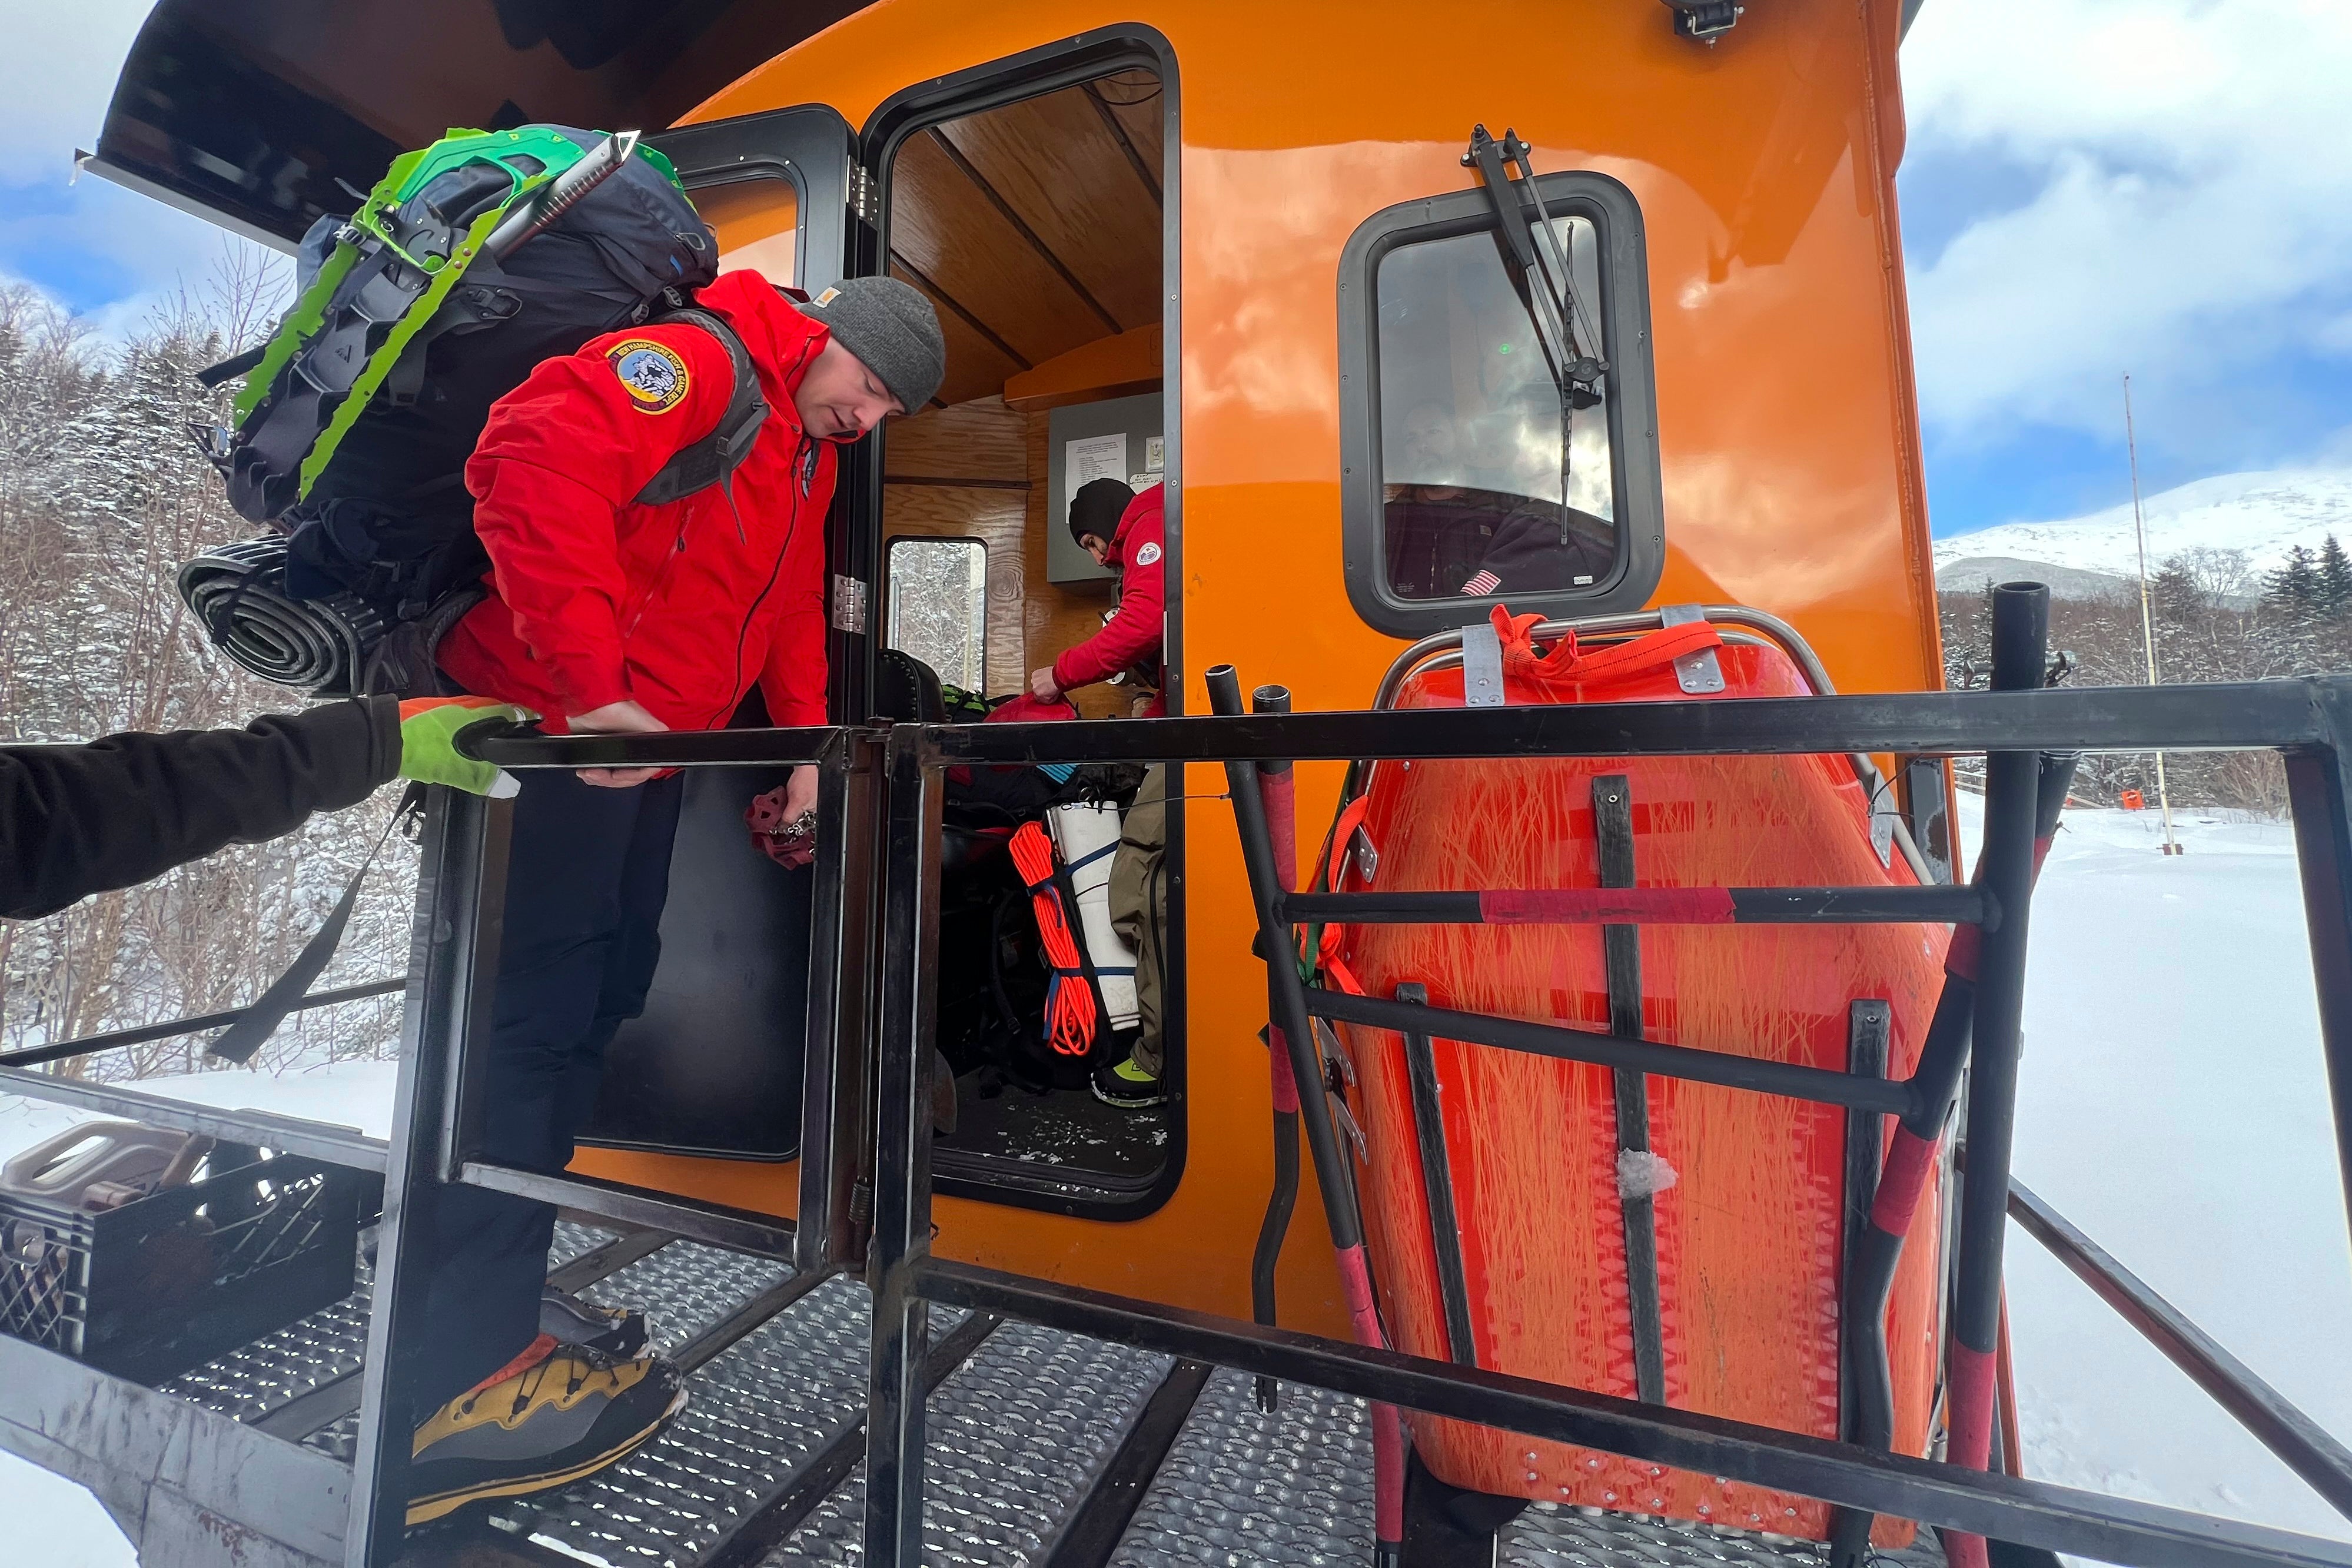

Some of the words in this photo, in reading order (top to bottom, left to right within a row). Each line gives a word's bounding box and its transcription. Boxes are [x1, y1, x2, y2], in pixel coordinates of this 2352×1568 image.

[616, 345, 631, 357] NEW
[627, 343, 669, 357] HAMPSHIRE
[667, 354, 682, 369] FISH
[675, 376, 686, 394] GAME
